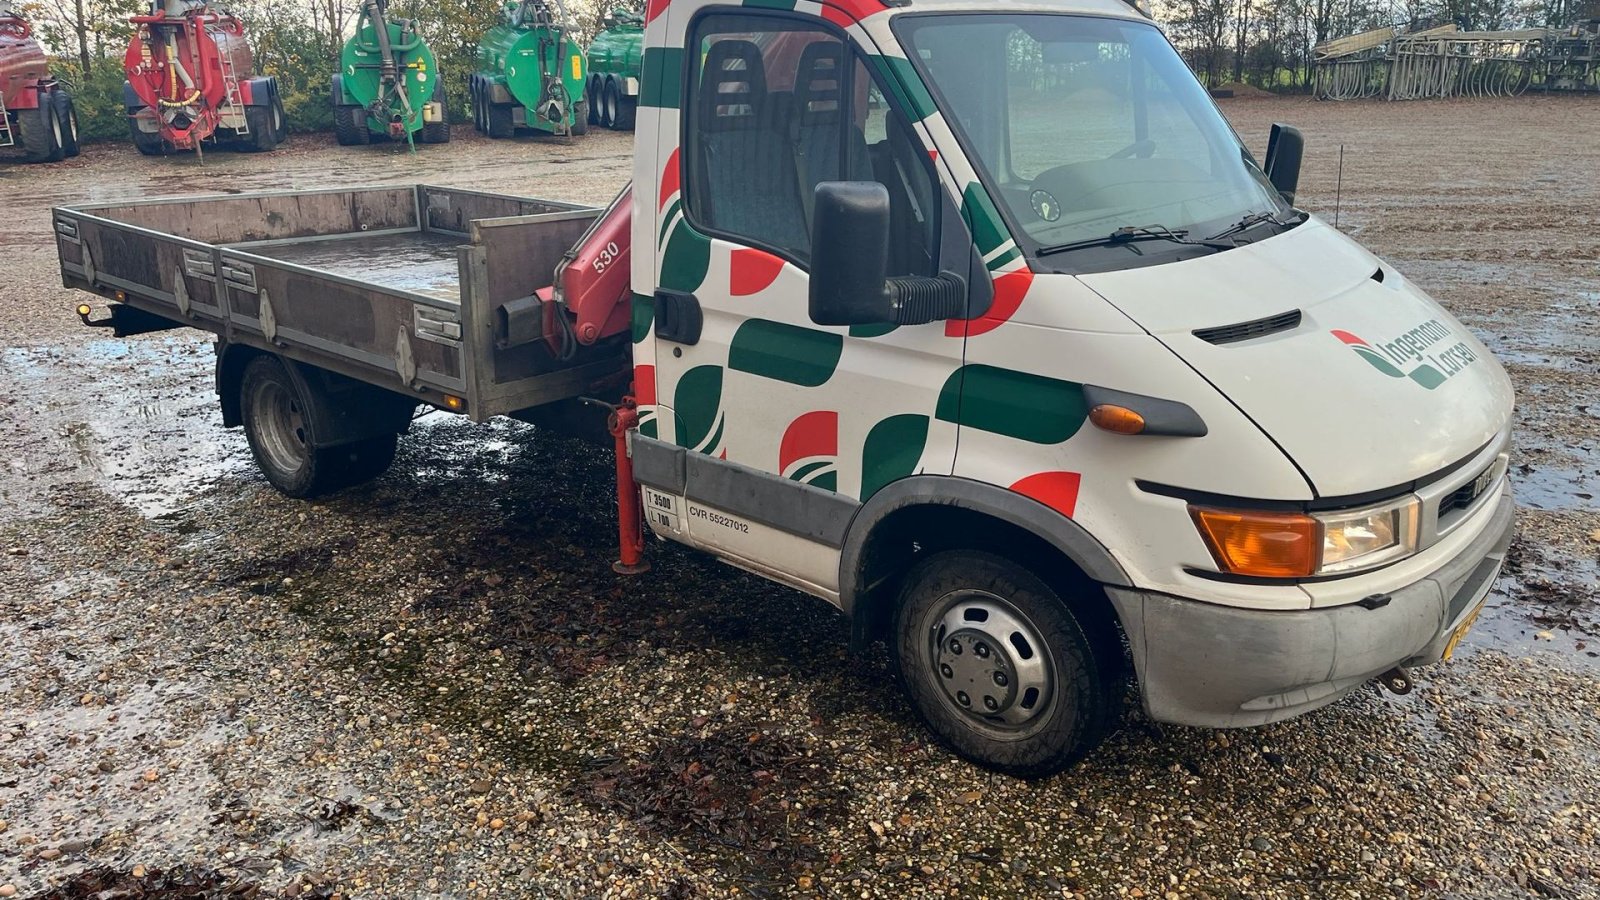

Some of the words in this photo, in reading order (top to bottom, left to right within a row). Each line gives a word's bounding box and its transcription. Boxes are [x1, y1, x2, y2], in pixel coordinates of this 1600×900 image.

[592, 242, 619, 274] 530
[1375, 319, 1452, 365] Ingemann
[1427, 341, 1478, 377] Larsen
[647, 491, 653, 504] T
[654, 493, 671, 510] 3500
[650, 510, 656, 523] L
[657, 512, 670, 528] 700
[689, 506, 708, 520] CVR
[709, 513, 749, 533] 55227012
